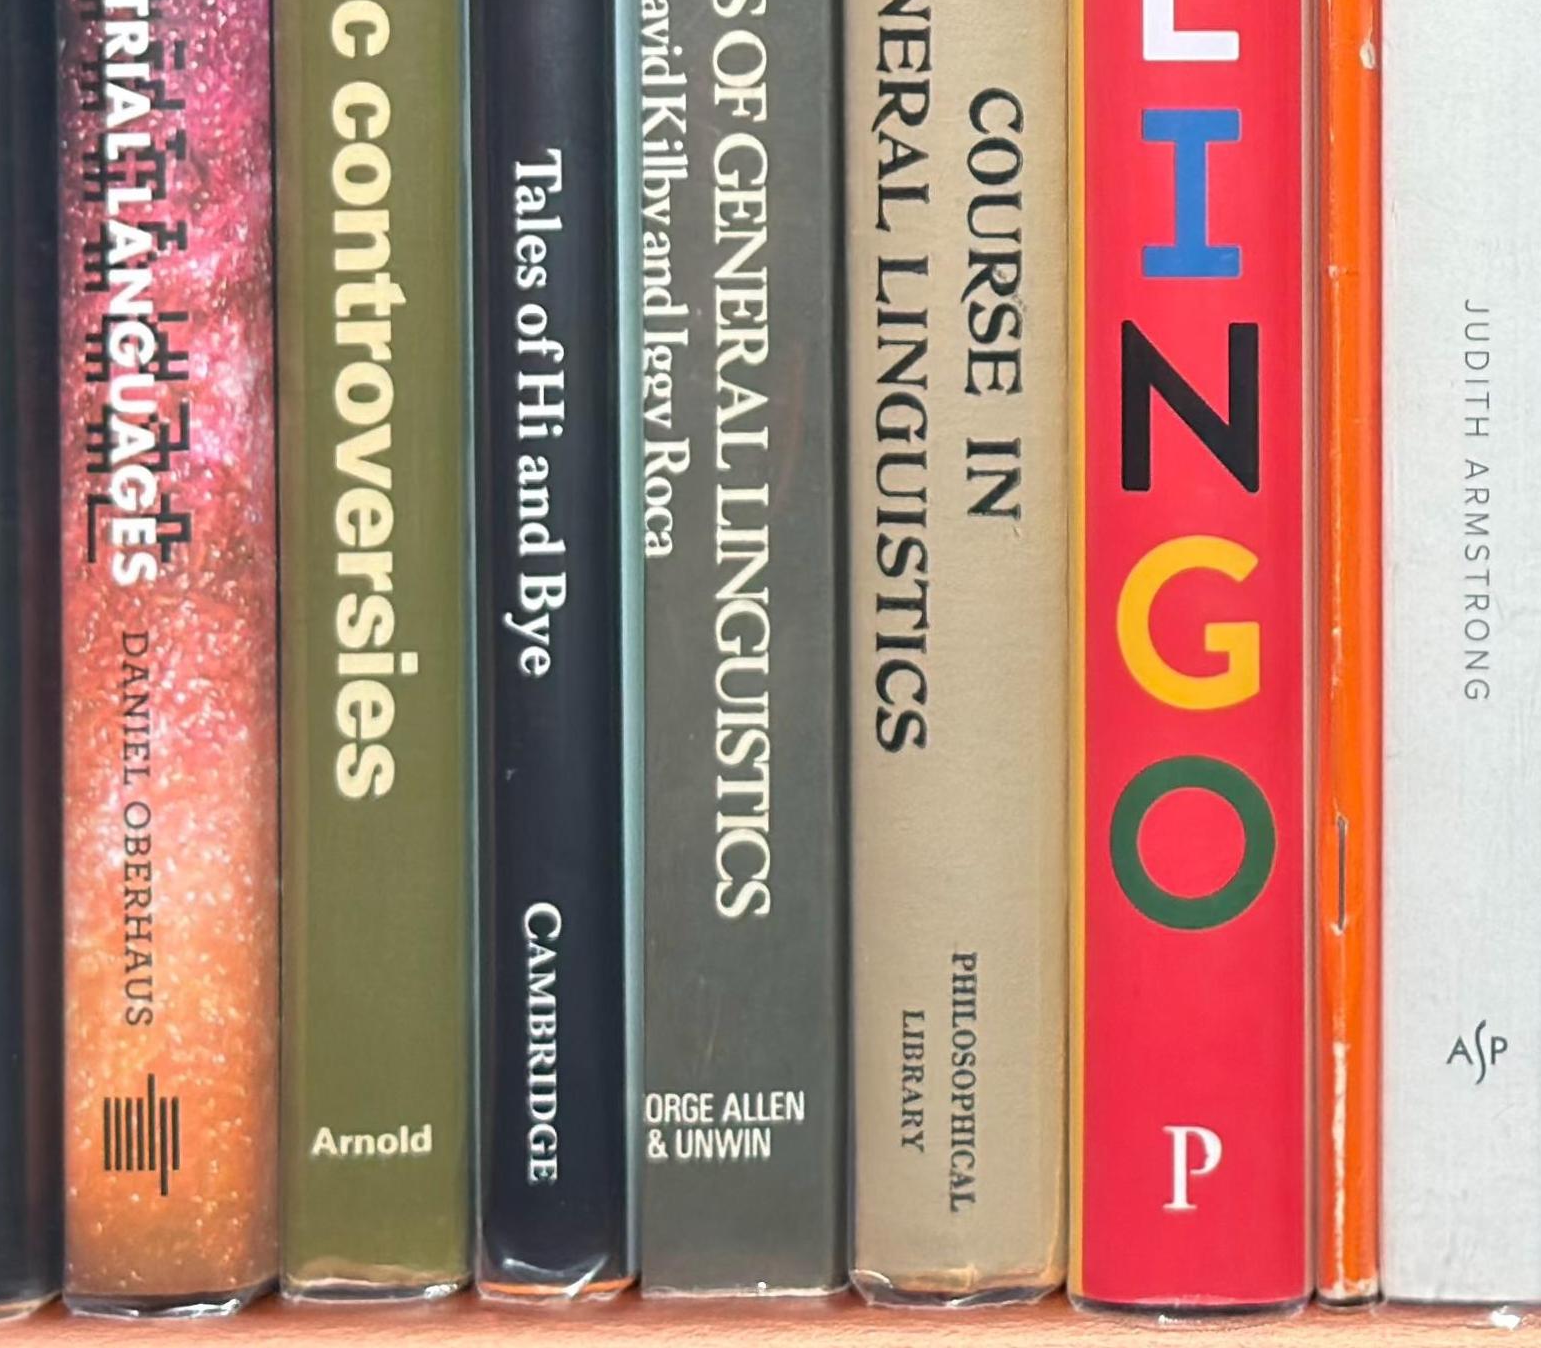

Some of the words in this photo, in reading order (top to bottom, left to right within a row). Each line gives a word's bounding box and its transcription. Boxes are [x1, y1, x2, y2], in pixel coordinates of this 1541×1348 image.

[713, 29, 768, 122] OF
[515, 148, 563, 290] Tales
[642, 228, 688, 317] and
[960, 88, 1025, 396] COURSE
[516, 303, 565, 360] of
[713, 131, 769, 470] GENERAL
[1464, 299, 1490, 438] JUDITH
[103, 187, 159, 587] LANGUAGES
[329, 81, 419, 800] controversies
[517, 370, 565, 439] Hi
[517, 455, 566, 556] and
[643, 437, 691, 558] Roca
[874, 255, 930, 754] LINGUISTICS
[966, 437, 1023, 521] IN
[504, 573, 568, 679] Bye
[1462, 458, 1490, 701] ARMSTRONG
[121, 630, 152, 785] DANIEL
[715, 483, 771, 918] LINGUISTICS
[123, 801, 154, 1027] OBERHAUS
[524, 902, 562, 1184] CAMBRIDGE
[722, 1090, 805, 1122] ALLEN
[900, 1009, 926, 1154] LIBRARY
[948, 952, 978, 1214] PHILOSOPHICAL
[311, 1125, 433, 1157] Arnold
[647, 1128, 669, 1158] &
[675, 1127, 771, 1158] UNWIN
